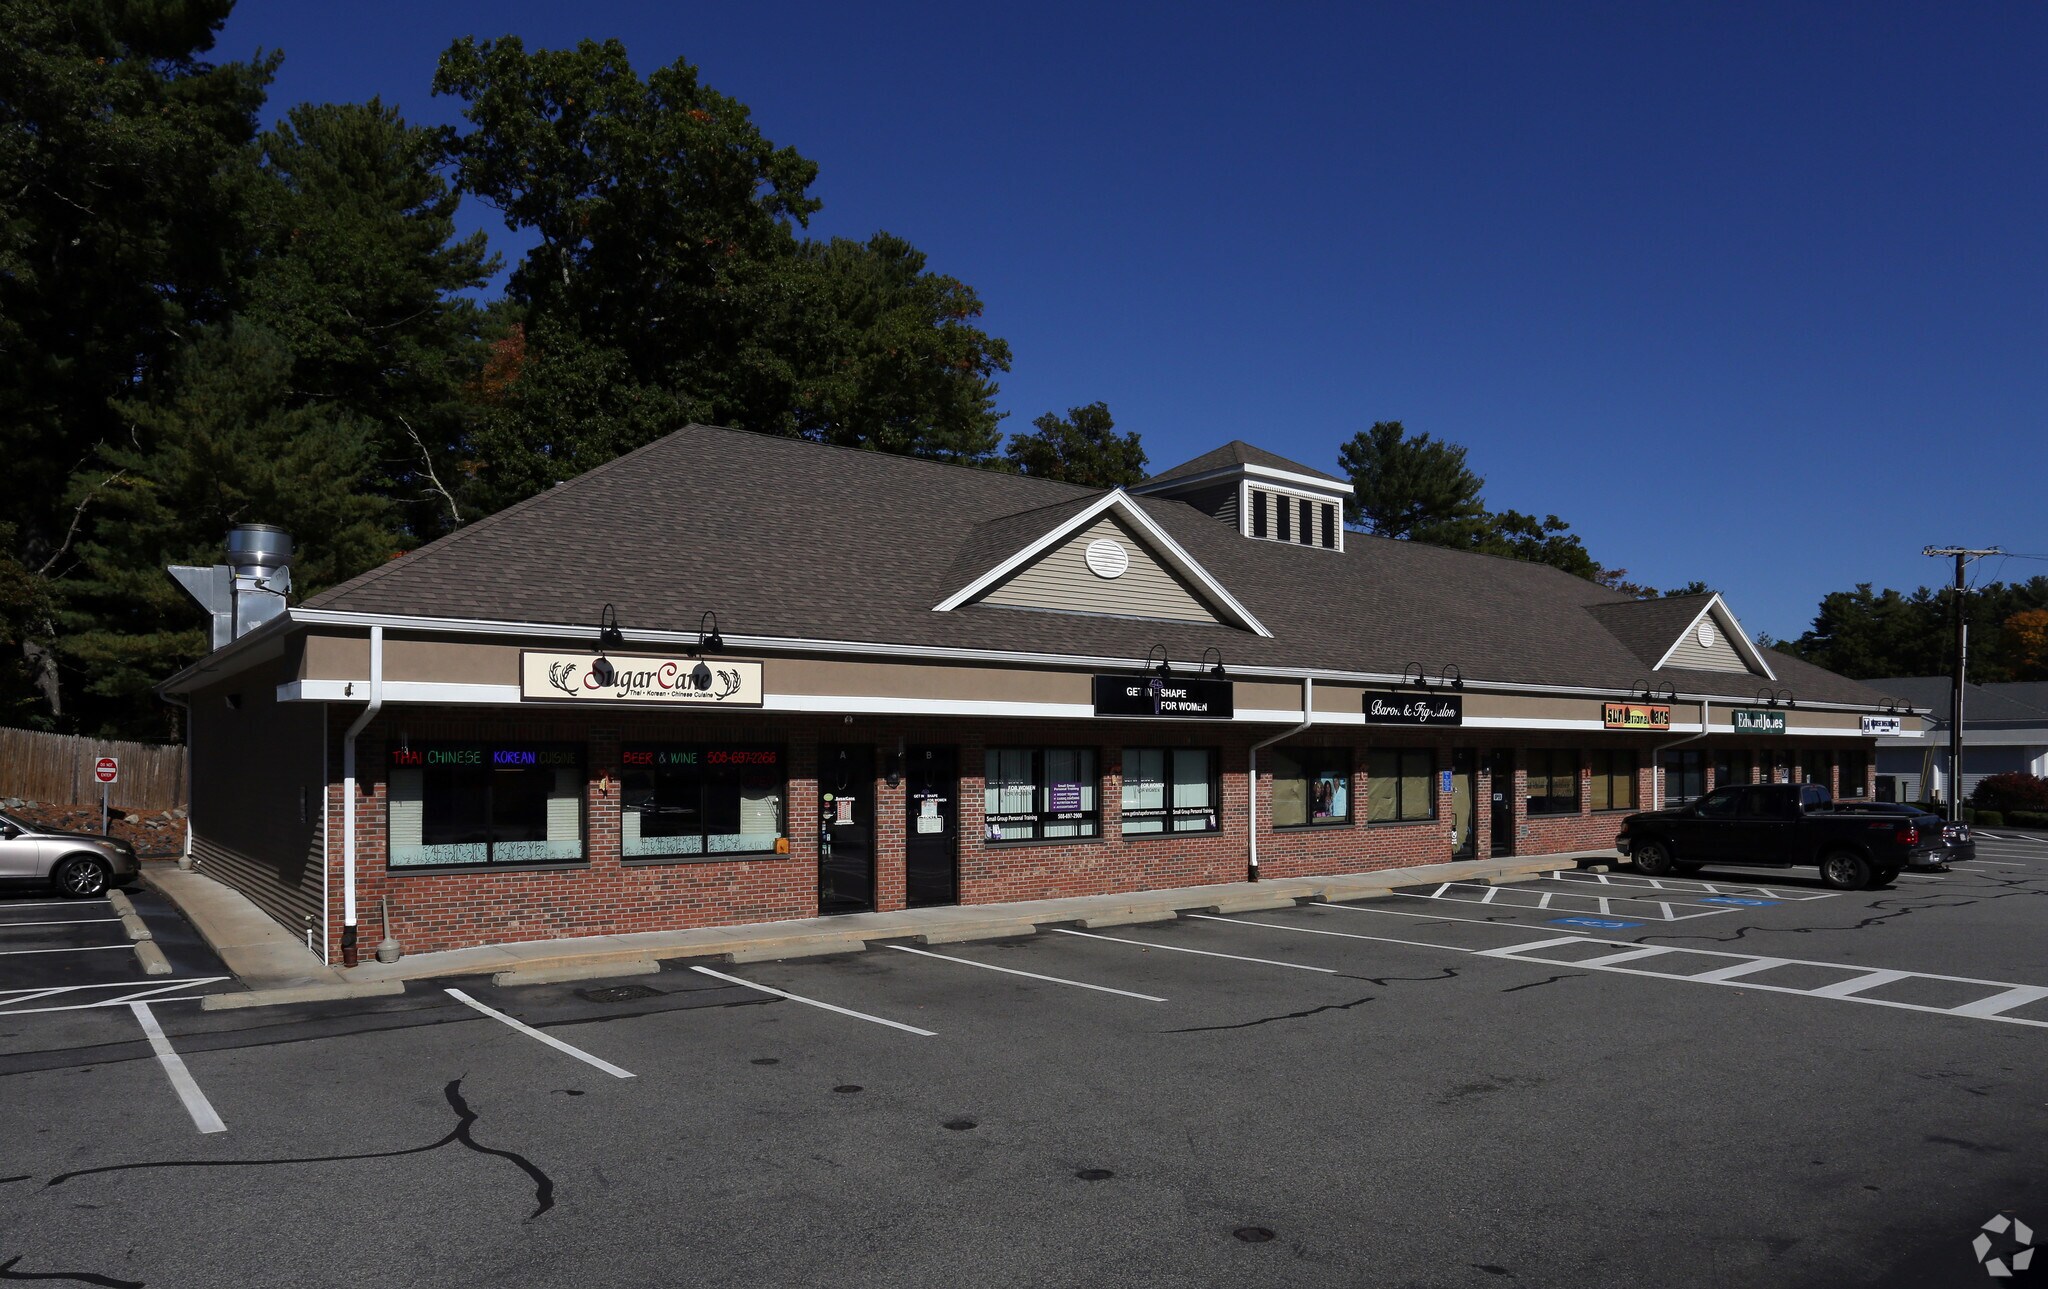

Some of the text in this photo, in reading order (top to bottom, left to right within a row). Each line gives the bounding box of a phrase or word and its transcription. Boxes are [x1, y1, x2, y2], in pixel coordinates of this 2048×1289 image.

[629, 689, 642, 697] Thai
[1126, 686, 1141, 697] GET
[1160, 689, 1187, 698] SHAPE
[1160, 701, 1208, 711] FOR WOMEN
[1371, 699, 1401, 716] Baron
[1403, 704, 1413, 716] &
[1413, 702, 1431, 722] Fig
[392, 751, 576, 765] THAI CHINESE KOREAN CUISINE
[623, 751, 776, 764] BEER & WINE 508-697-2266
[839, 751, 847, 759] A
[1024, 814, 1037, 822] Training
